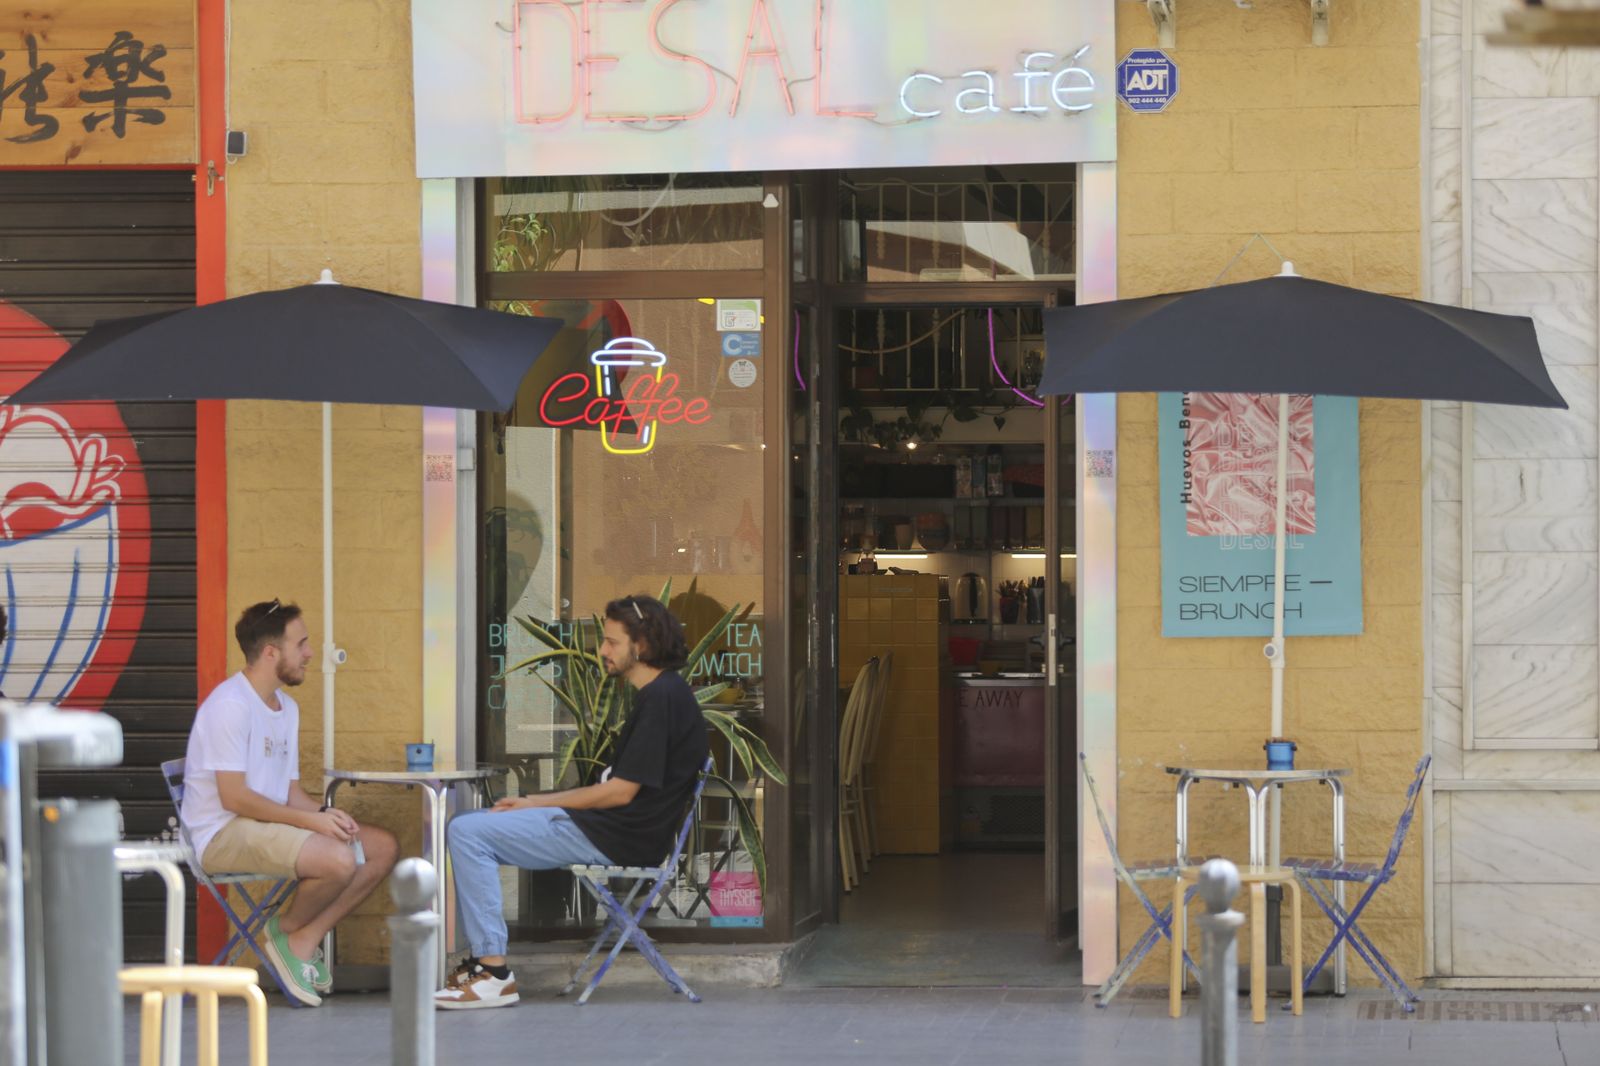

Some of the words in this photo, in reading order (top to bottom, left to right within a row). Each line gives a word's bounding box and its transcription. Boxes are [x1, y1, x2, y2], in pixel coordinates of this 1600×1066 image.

[514, 0, 877, 124] DESAL
[900, 44, 1095, 118] café
[1127, 70, 1168, 91] ADT
[539, 372, 712, 442] Coffee
[1180, 440, 1192, 504] Huevos
[727, 623, 762, 647] TEA
[976, 689, 1024, 708] AWAY
